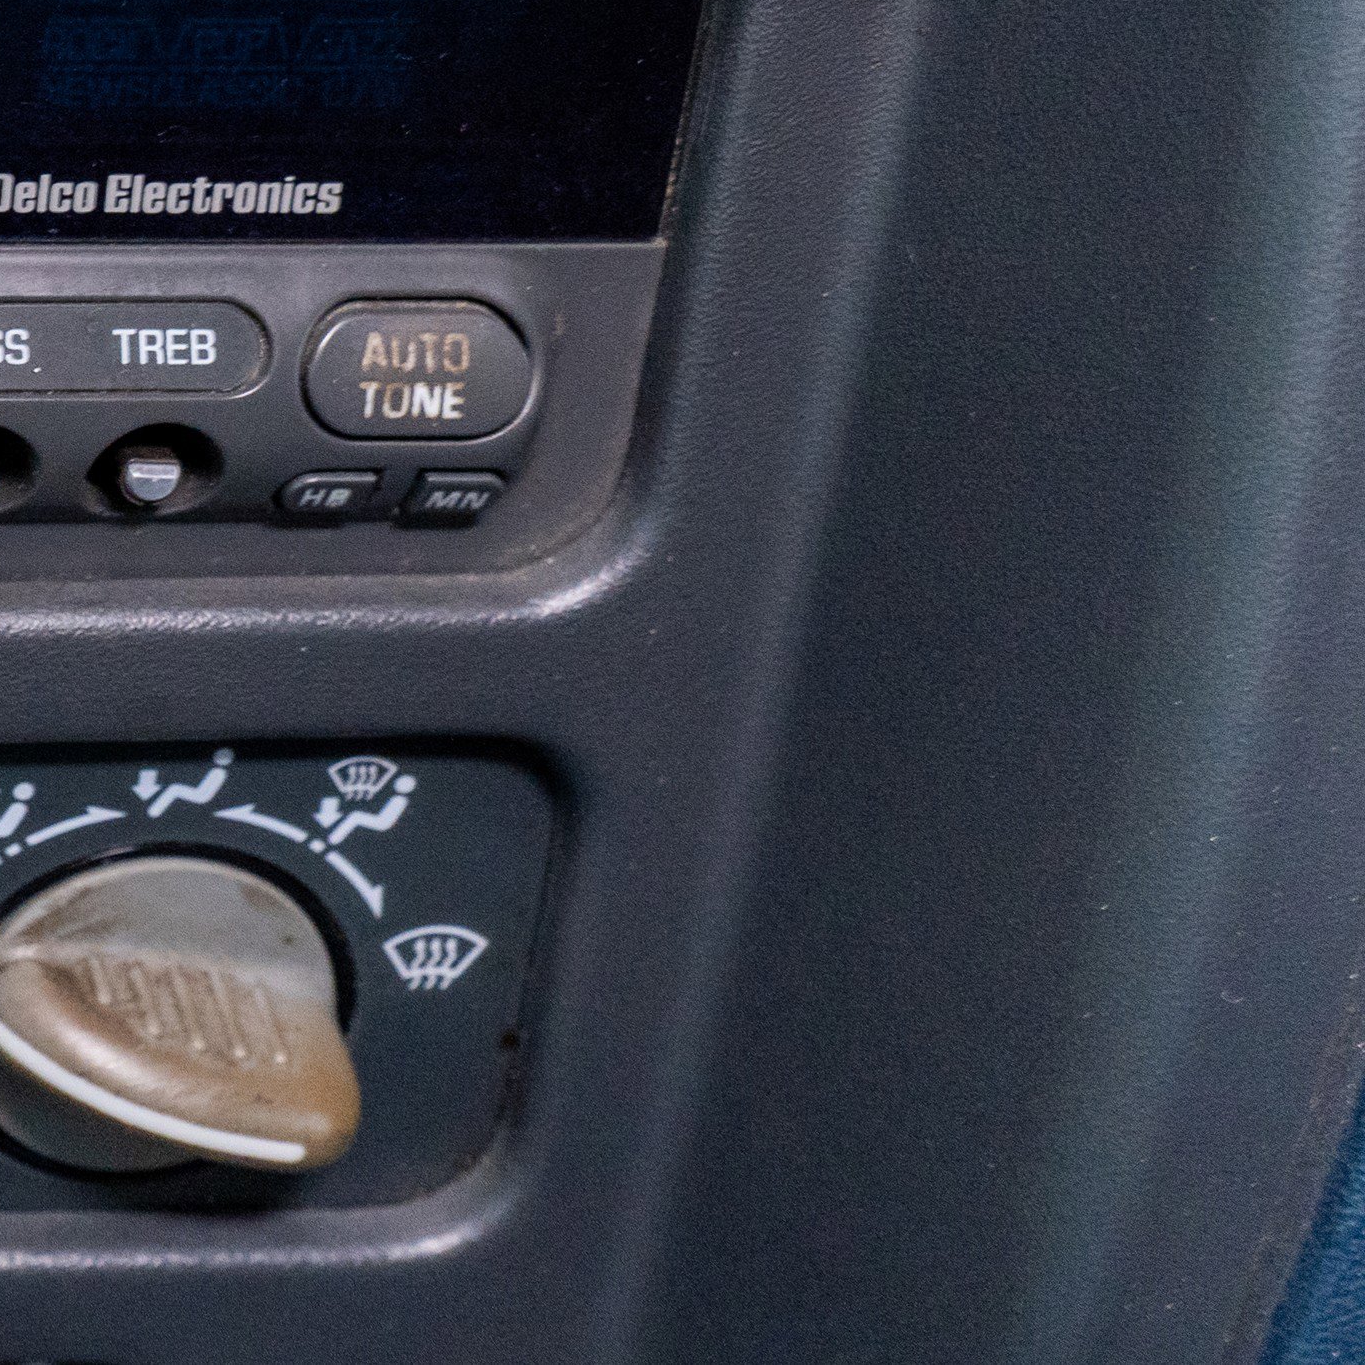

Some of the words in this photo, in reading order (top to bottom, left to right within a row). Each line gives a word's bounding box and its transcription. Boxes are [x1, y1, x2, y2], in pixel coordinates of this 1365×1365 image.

[103, 173, 343, 215] Electronics
[111, 328, 217, 366] TREB
[361, 331, 470, 373] AUTO
[360, 381, 464, 419] TONE
